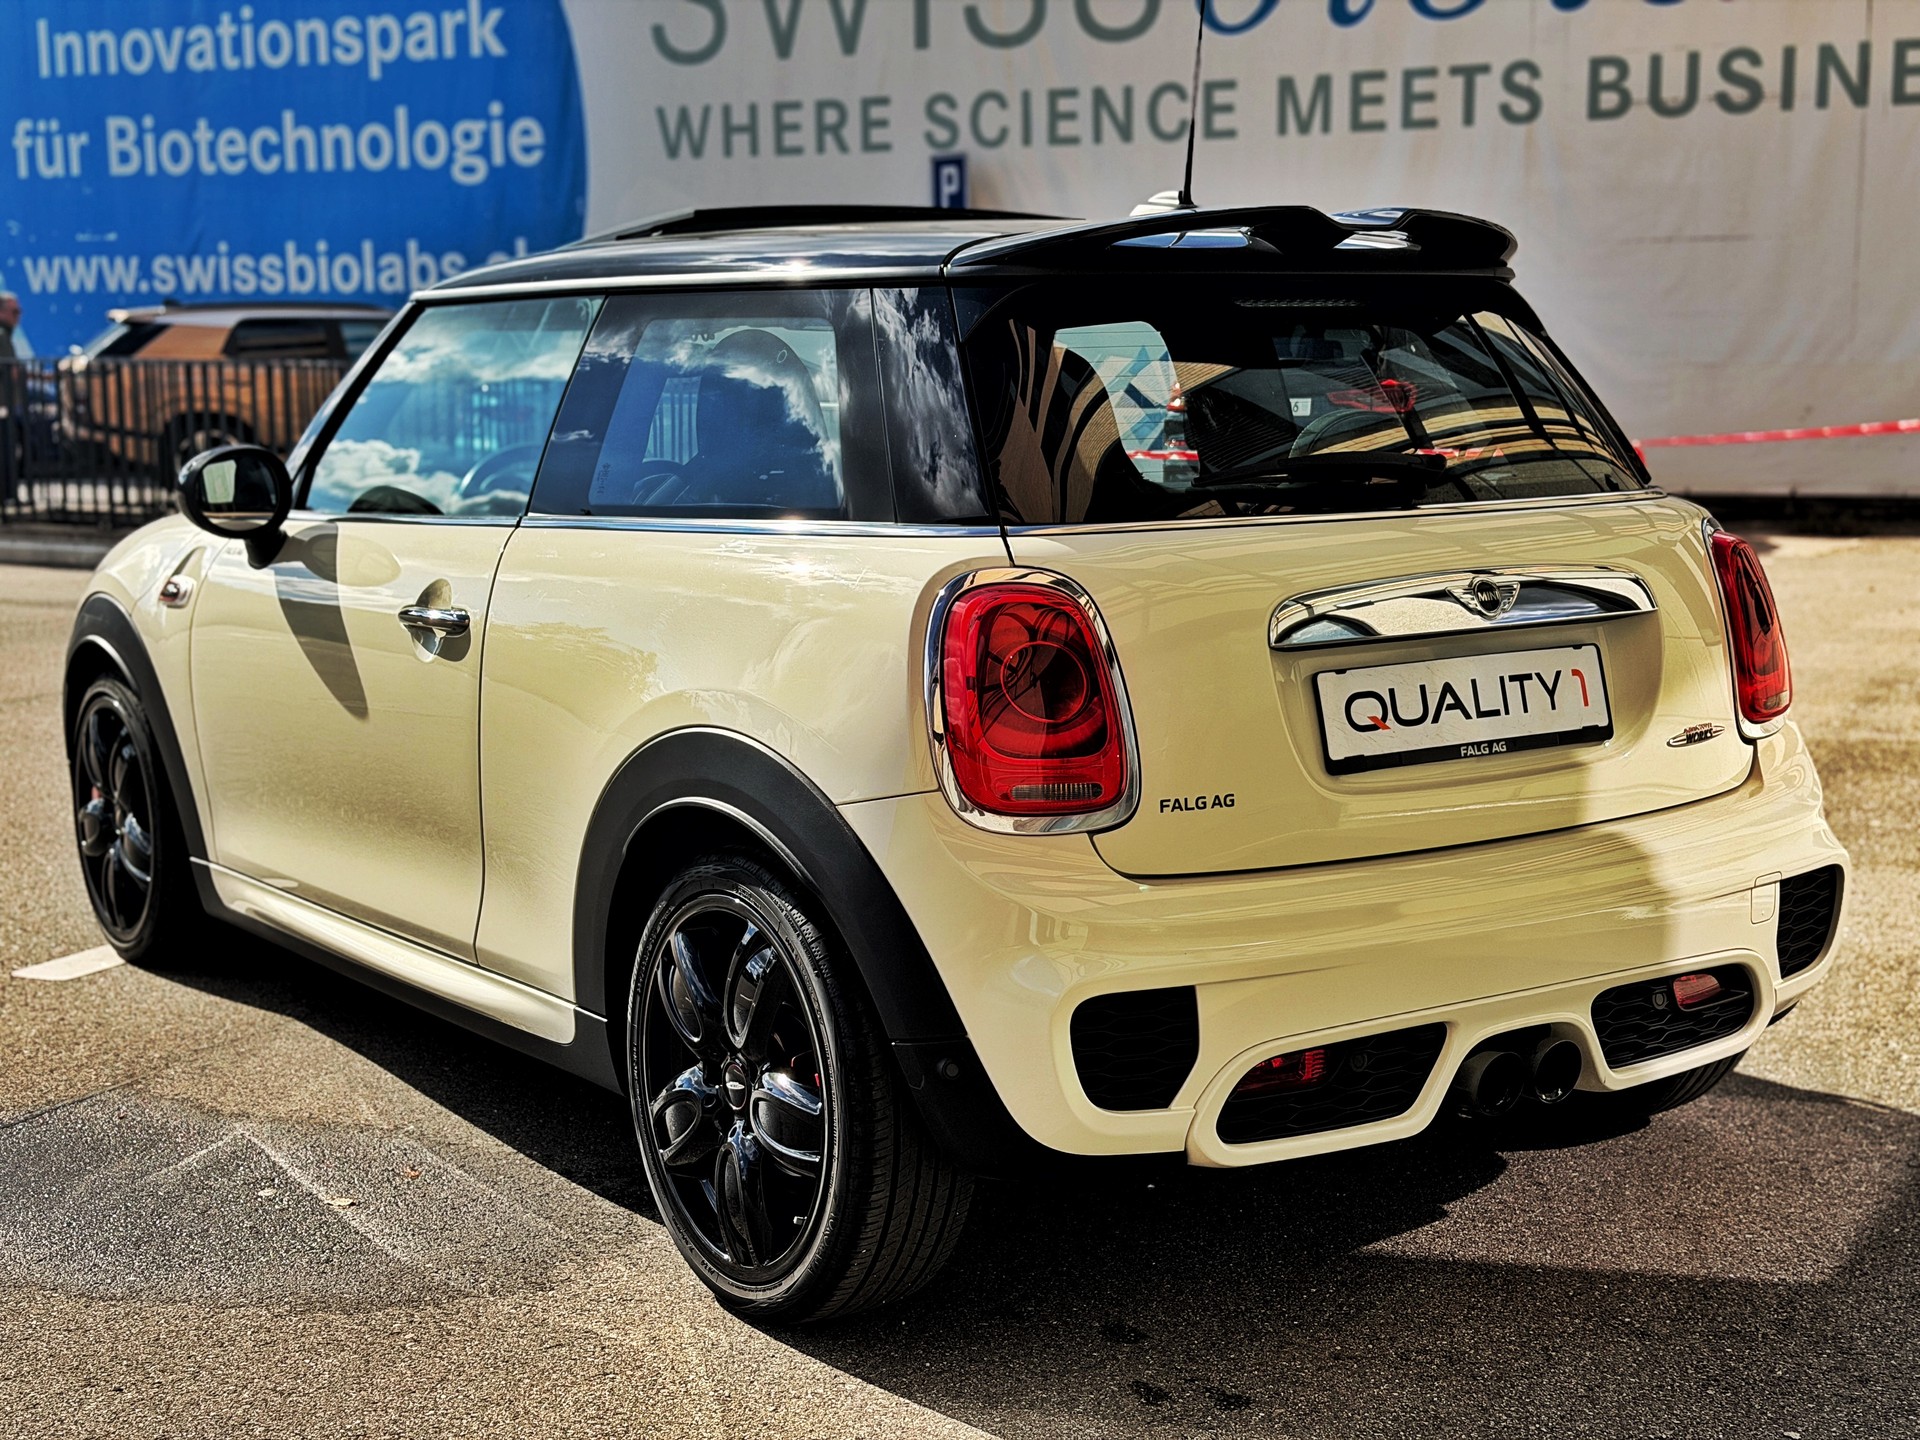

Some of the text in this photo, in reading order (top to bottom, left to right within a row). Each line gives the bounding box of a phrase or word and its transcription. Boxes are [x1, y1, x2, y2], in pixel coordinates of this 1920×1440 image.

[36, 0, 507, 80] Innovationspark
[655, 38, 1920, 159] WHERE SCIENCE MEETS BUSINE
[12, 101, 546, 185] für Biotechnologie
[940, 164, 960, 208] P
[22, 237, 528, 294] www.swissbiolabs
[1477, 590, 1500, 602] MINI
[1344, 668, 1589, 733] QUALITY 1
[1460, 741, 1507, 757] FALG AG
[1160, 793, 1235, 813] FALG AG
